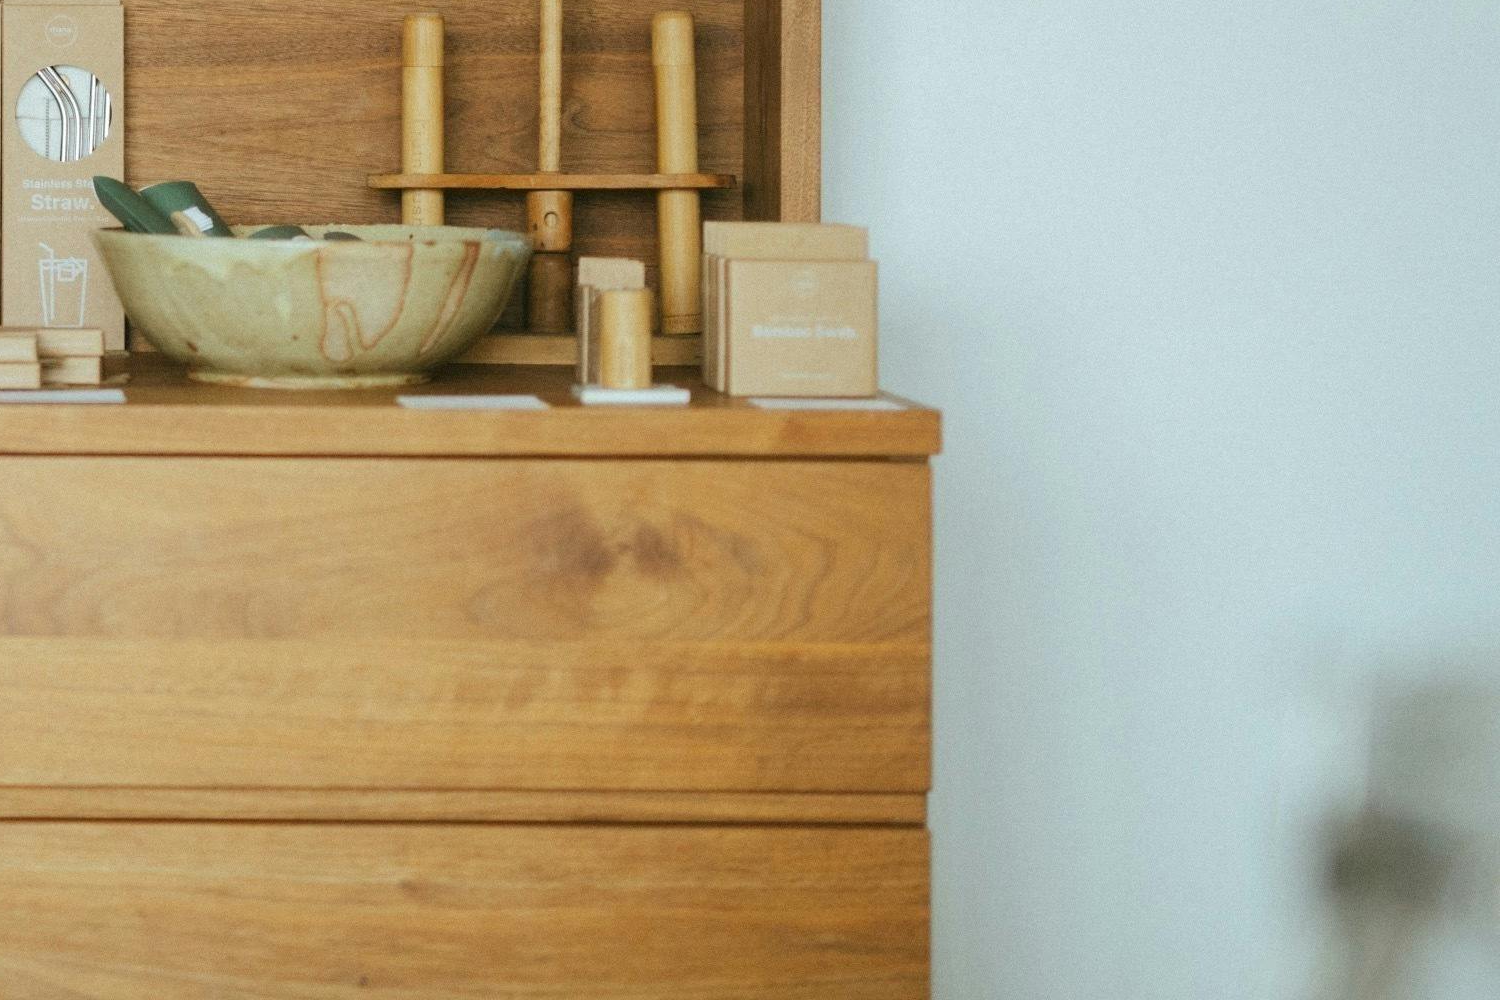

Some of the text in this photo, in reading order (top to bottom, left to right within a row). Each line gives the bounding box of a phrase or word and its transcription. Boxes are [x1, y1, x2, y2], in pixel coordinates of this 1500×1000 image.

[22, 178, 94, 189] Stainless Ste
[31, 194, 95, 211] Straw.
